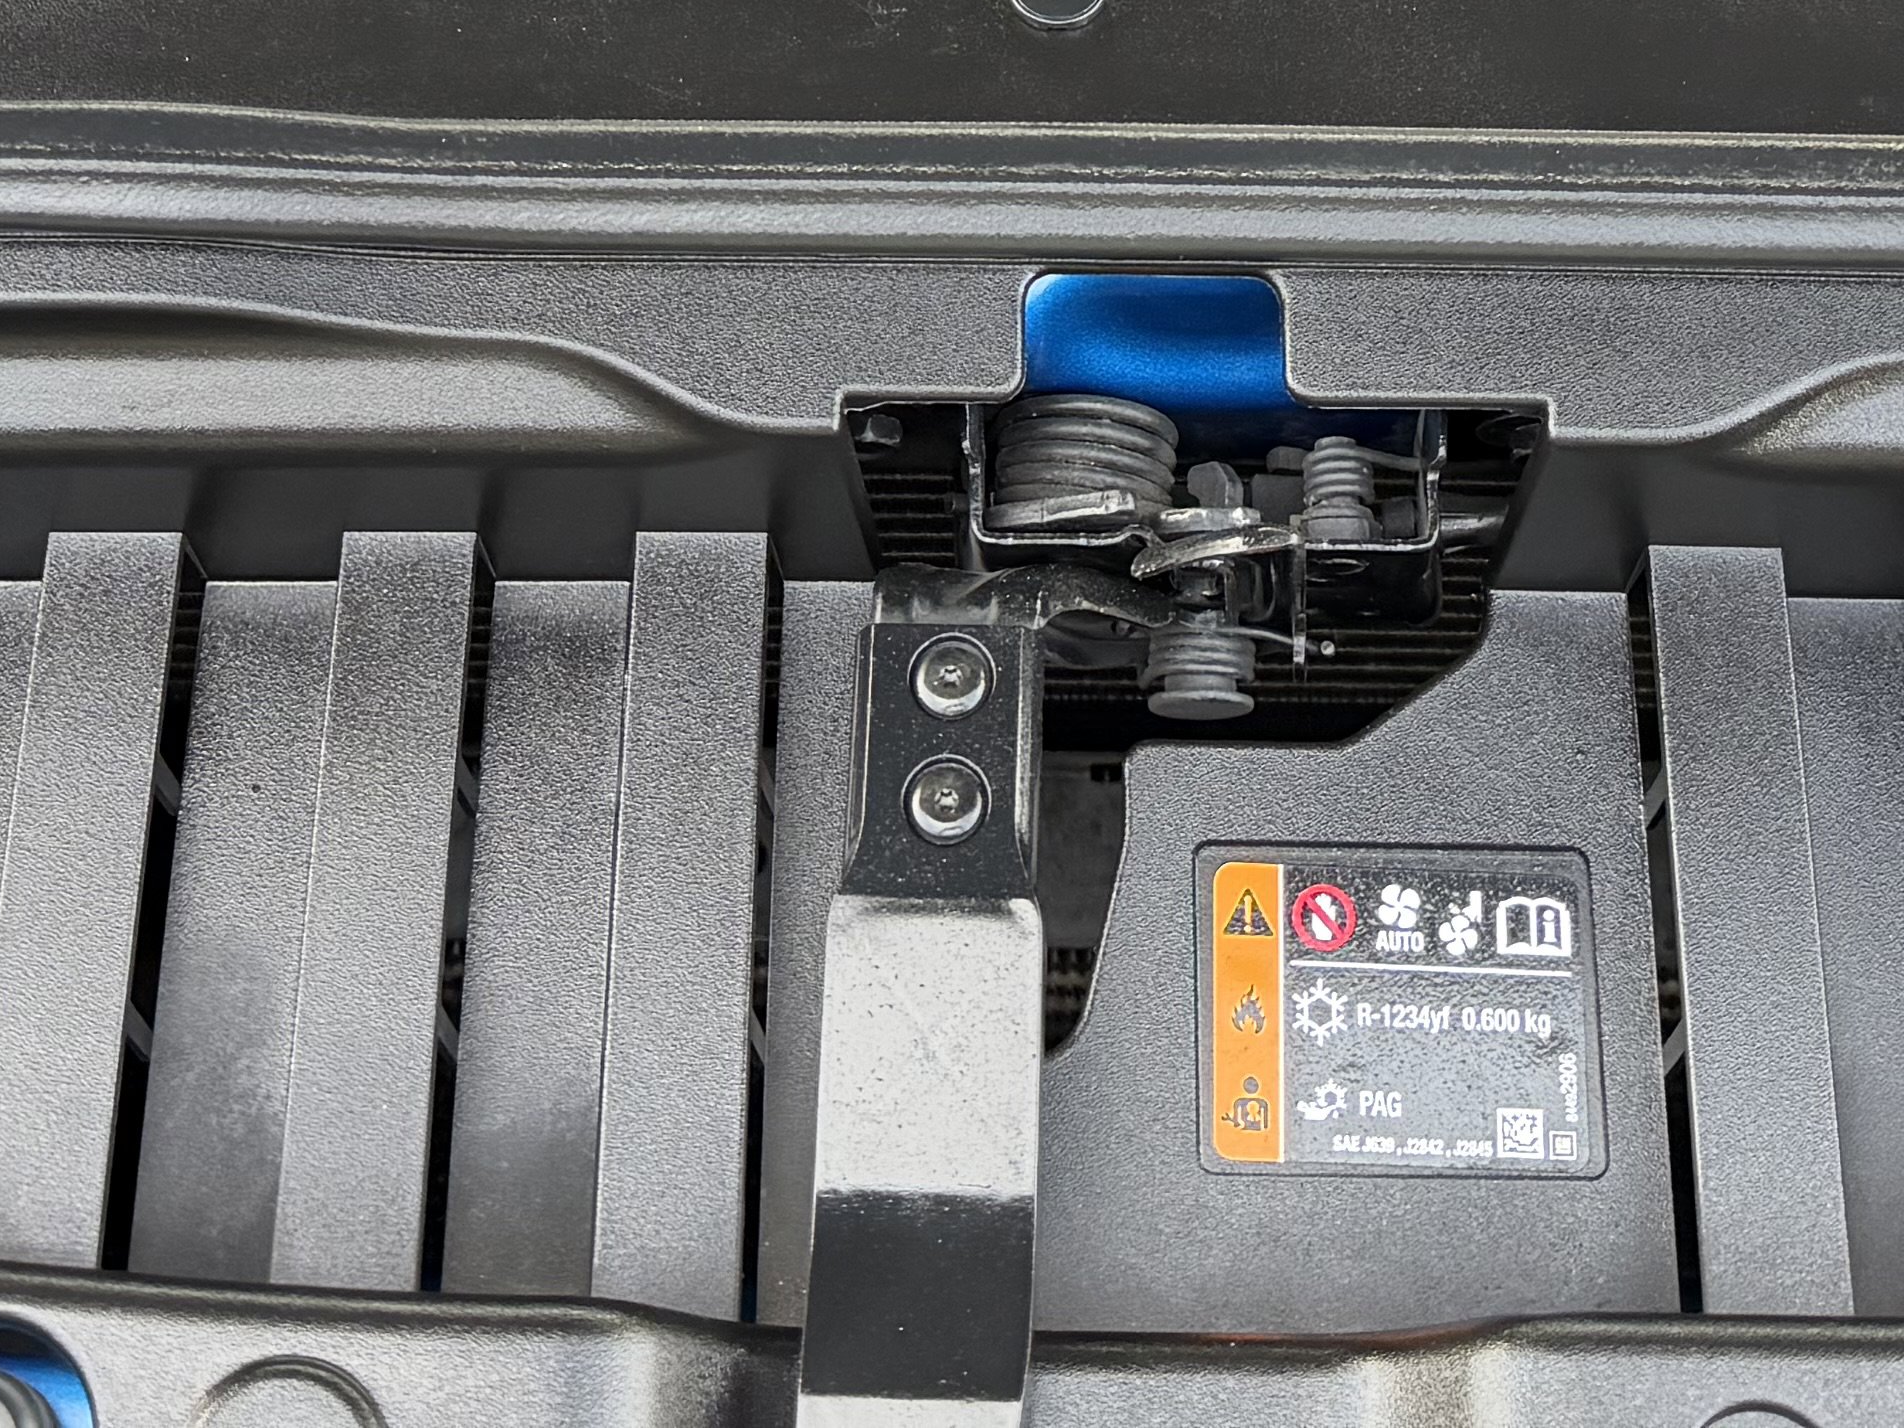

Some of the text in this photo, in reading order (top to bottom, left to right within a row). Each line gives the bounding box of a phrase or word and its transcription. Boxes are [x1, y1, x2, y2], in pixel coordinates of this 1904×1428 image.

[1375, 930, 1425, 953] AUTO
[1356, 1002, 1552, 1040] R-1234yf 0.600 kg
[1358, 1090, 1402, 1118] PAG
[1333, 1134, 1360, 1152] SAE
